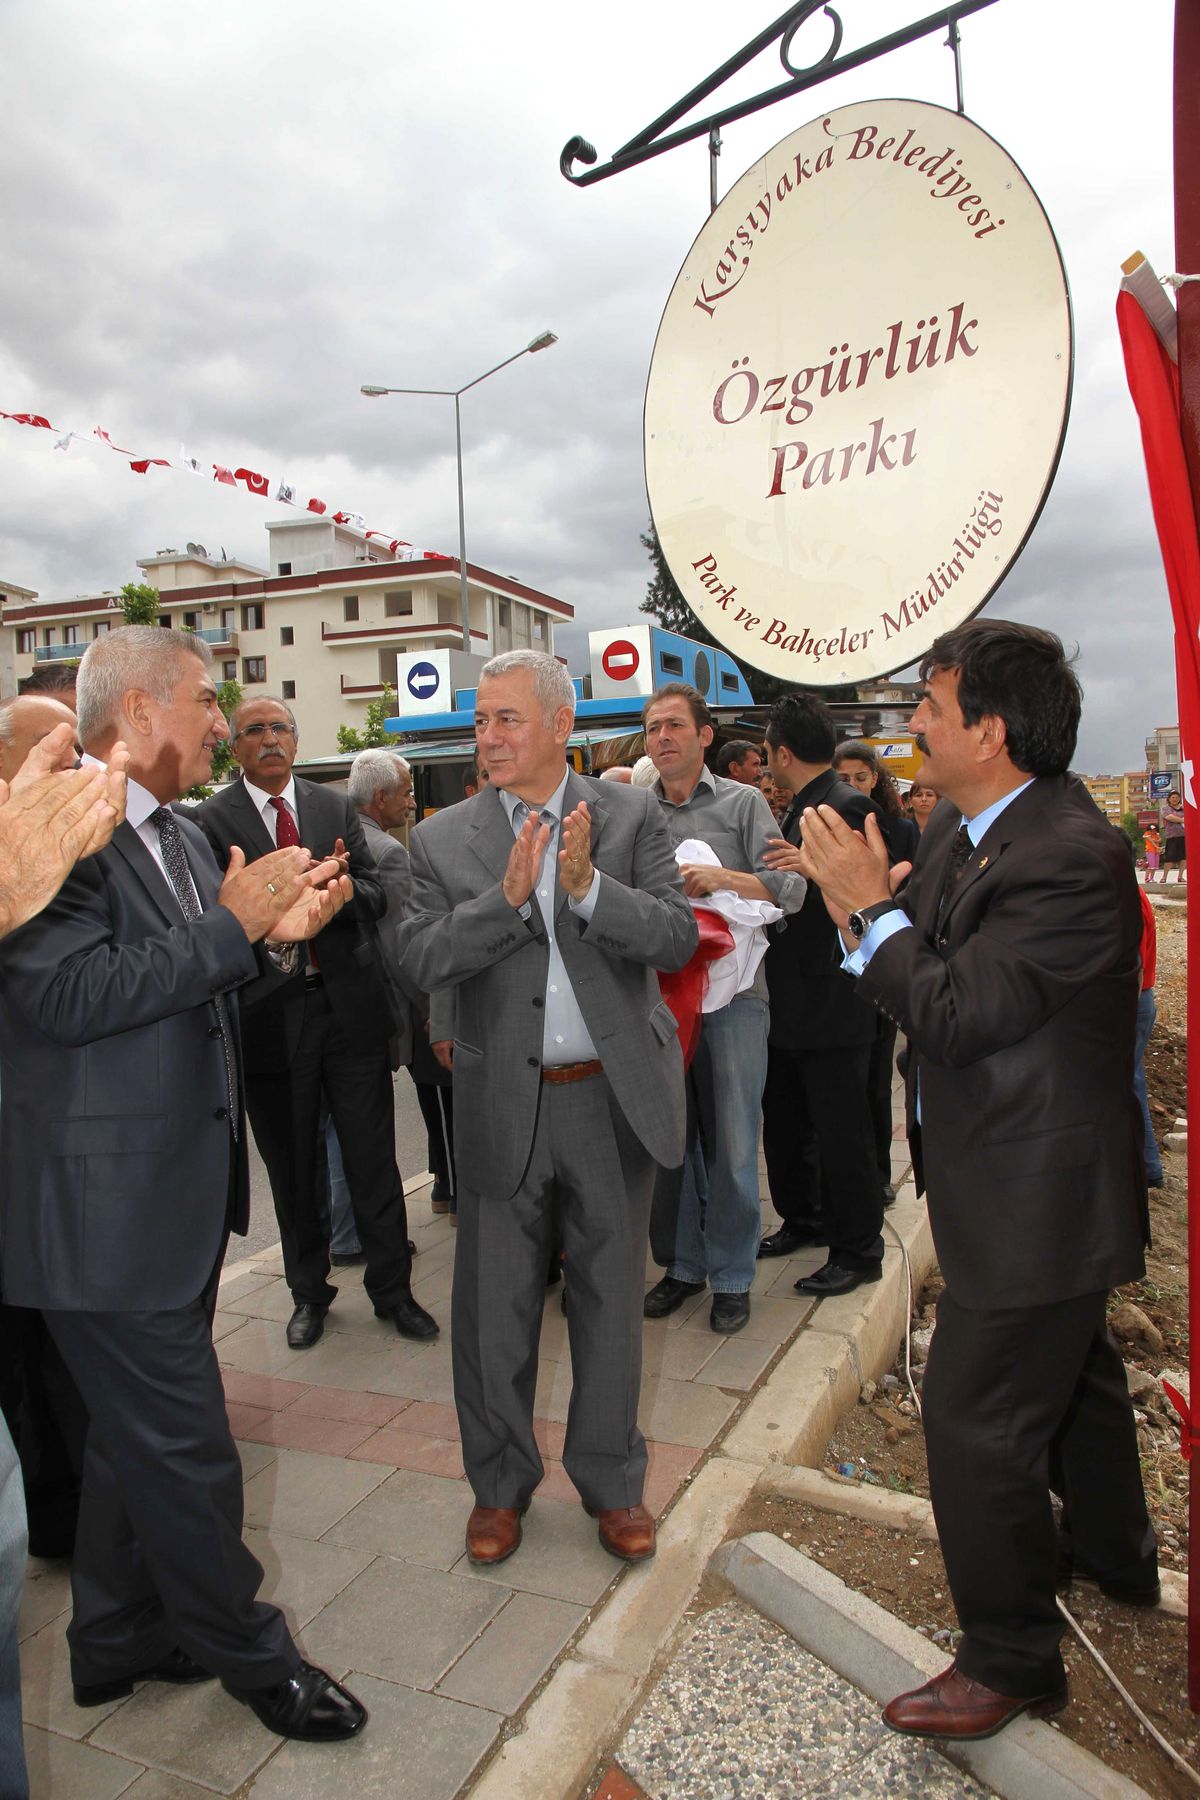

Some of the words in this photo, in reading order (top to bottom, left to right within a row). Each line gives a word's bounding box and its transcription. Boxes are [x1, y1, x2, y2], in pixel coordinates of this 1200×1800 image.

[693, 145, 834, 319] Karşıyaka
[822, 117, 1006, 240] Belediyesi
[712, 302, 980, 427] Özgürlük
[765, 417, 917, 499] Parkı
[690, 551, 738, 612] Park
[733, 605, 761, 632] ve
[760, 617, 874, 664] Bahçeler
[879, 489, 1004, 641] Müdürlüğü
